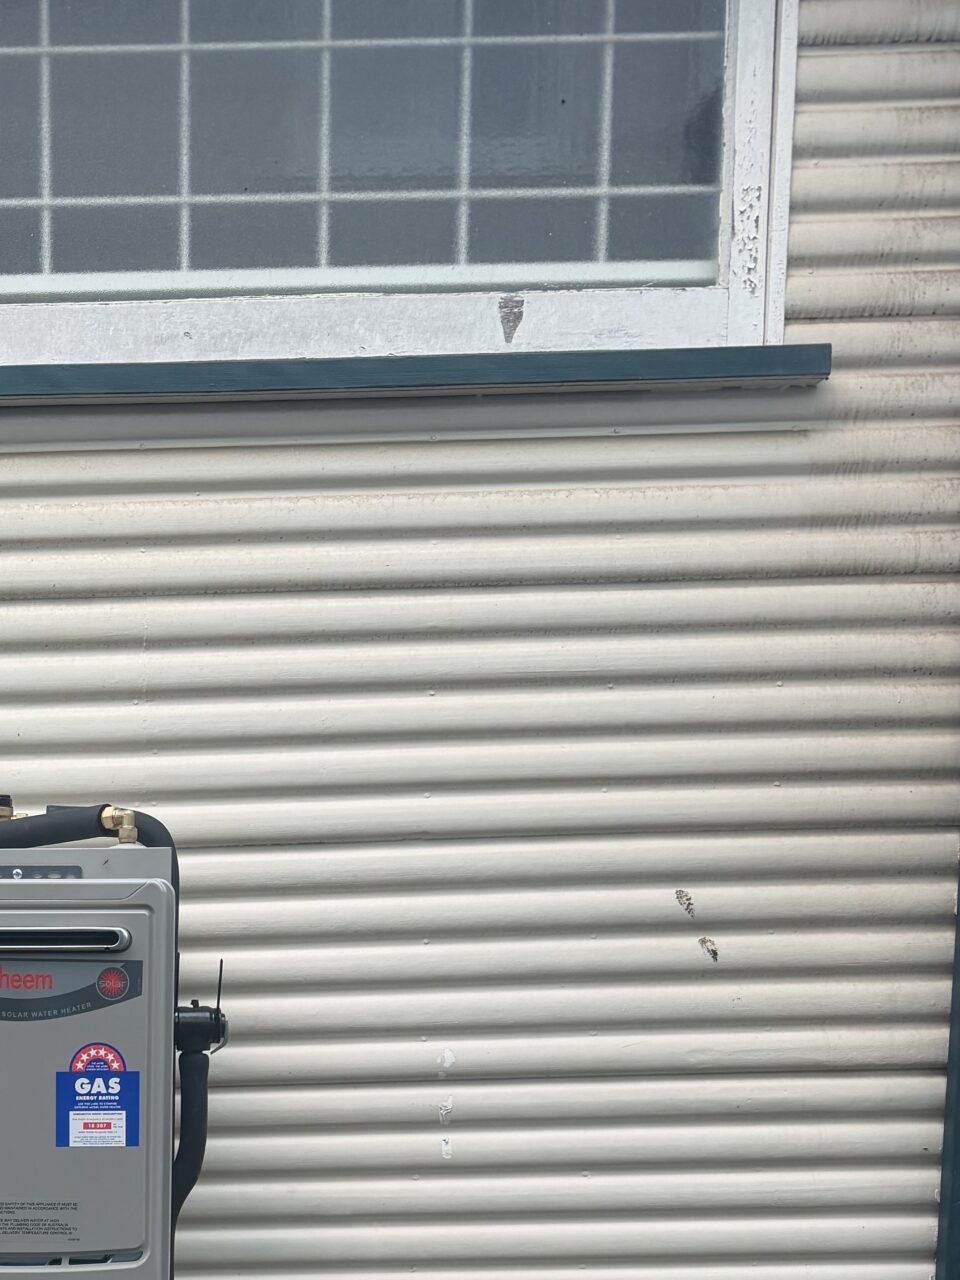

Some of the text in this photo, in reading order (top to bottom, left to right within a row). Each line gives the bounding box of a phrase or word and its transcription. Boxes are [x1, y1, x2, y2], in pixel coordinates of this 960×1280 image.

[99, 979, 128, 988] solar
[1, 1010, 28, 1018] SOLAR
[31, 1009, 58, 1017] WATER
[61, 1001, 92, 1014] HEATER
[74, 1077, 121, 1094] GAS
